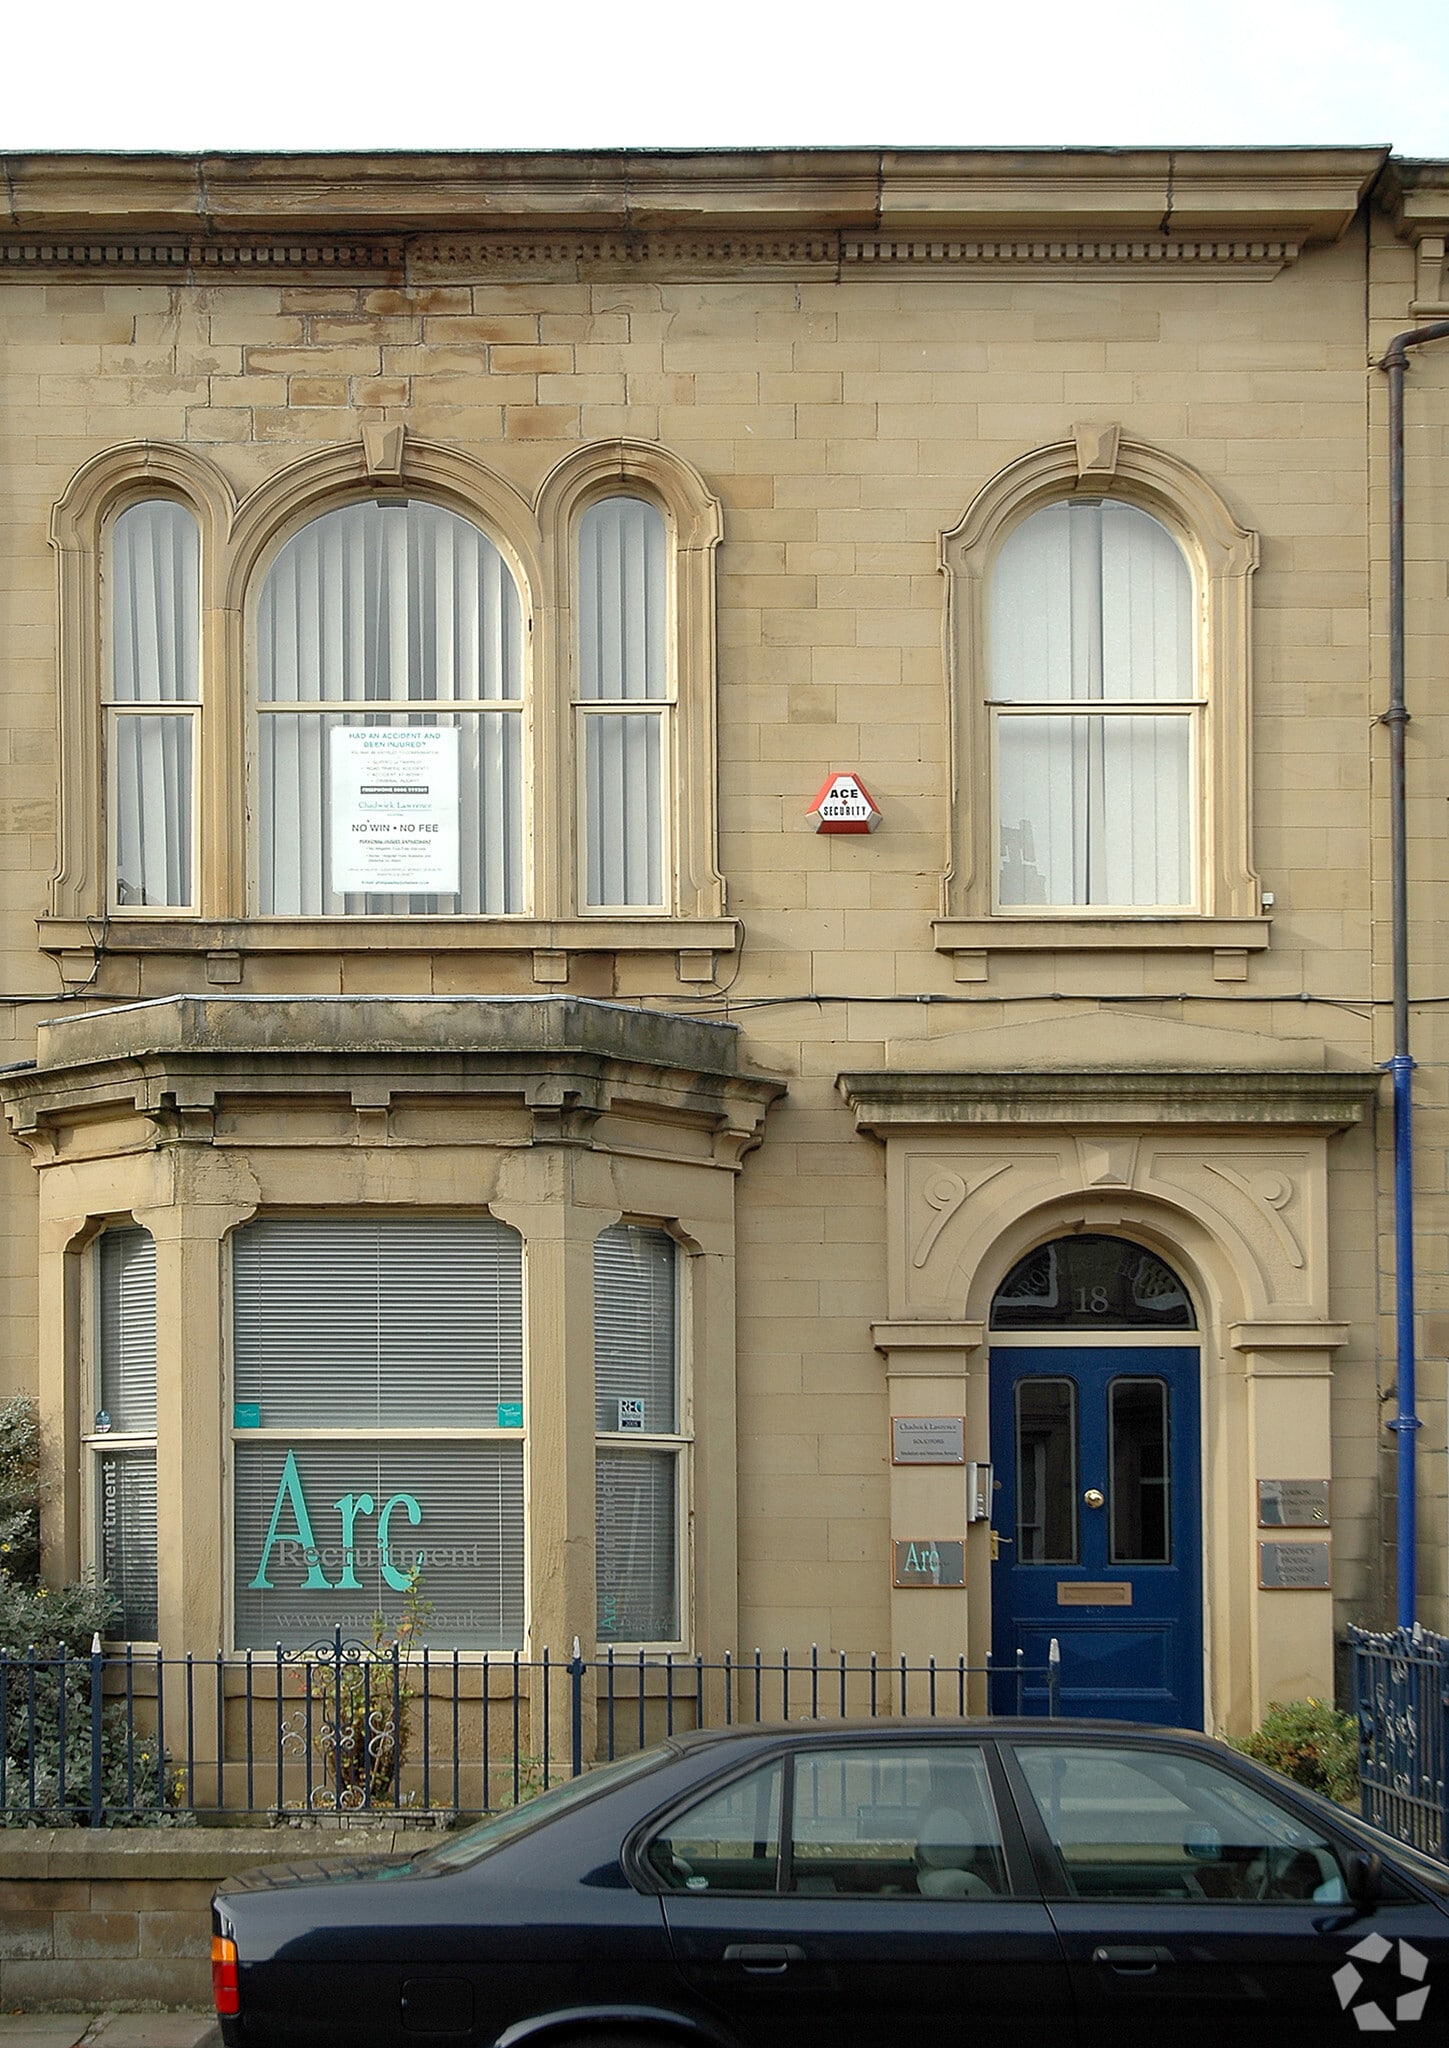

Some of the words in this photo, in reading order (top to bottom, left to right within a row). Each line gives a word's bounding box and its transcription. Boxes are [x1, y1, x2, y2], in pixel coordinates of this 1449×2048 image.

[358, 801, 394, 809] Chadwick
[396, 801, 432, 809] Lawrence
[830, 789, 858, 799] ACE
[823, 806, 866, 816] SECURITY
[352, 824, 367, 833] NO
[369, 824, 390, 833] WIN
[399, 824, 415, 833] NO
[418, 824, 439, 833] FEE
[1074, 1286, 1109, 1314] 18
[248, 1448, 424, 1592] Arc
[602, 1459, 617, 1592] recruitment
[277, 1539, 481, 1567] Recruitment
[903, 1541, 940, 1573] Arc
[600, 1595, 617, 1632] Arc
